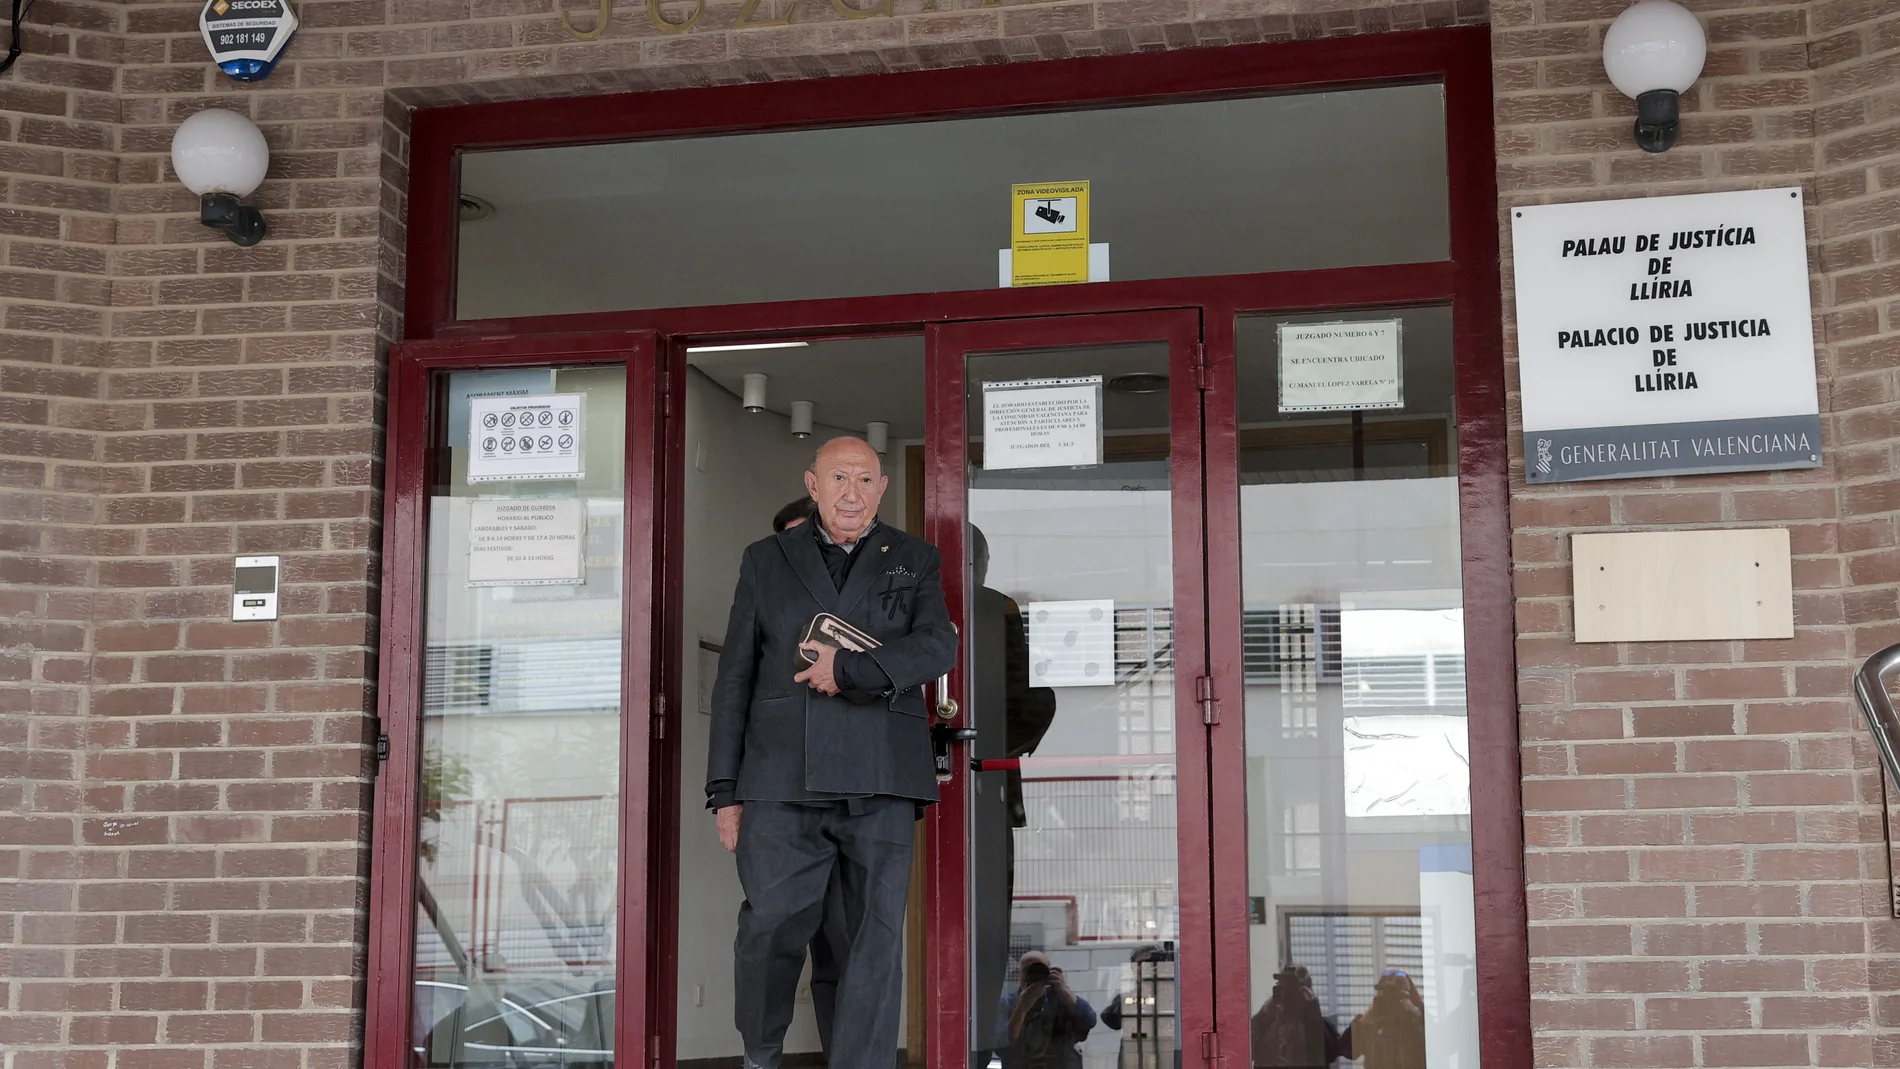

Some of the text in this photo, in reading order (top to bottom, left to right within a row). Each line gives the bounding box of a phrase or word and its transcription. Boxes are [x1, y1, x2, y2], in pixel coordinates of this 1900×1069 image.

[231, 0, 277, 10] SECOEX
[220, 32, 266, 45] 902 181 149
[1035, 186, 1085, 195] VIDEOVIGILADA
[1562, 224, 1756, 257] PALAU DE JUSTÍCIA
[1648, 257, 1672, 275] DE
[1630, 277, 1693, 300] LLÍRIA
[1295, 332, 1332, 340] JUZGADO
[1558, 319, 1771, 348] PALACIO DE JUSTICIA
[1302, 356, 1349, 364] ENCUENTRA
[1653, 349, 1677, 367] DE
[1635, 369, 1698, 392] LLÍRIA
[1028, 399, 1067, 407] ESTABLECIDO
[989, 407, 1020, 415] DIRECCIÓN
[1001, 412, 1034, 420] COMUNIDAD
[1034, 410, 1073, 418] VALENCIANA
[1561, 432, 1811, 465] GENERALITAT VALENCIANA
[496, 505, 522, 513] JUZGADO
